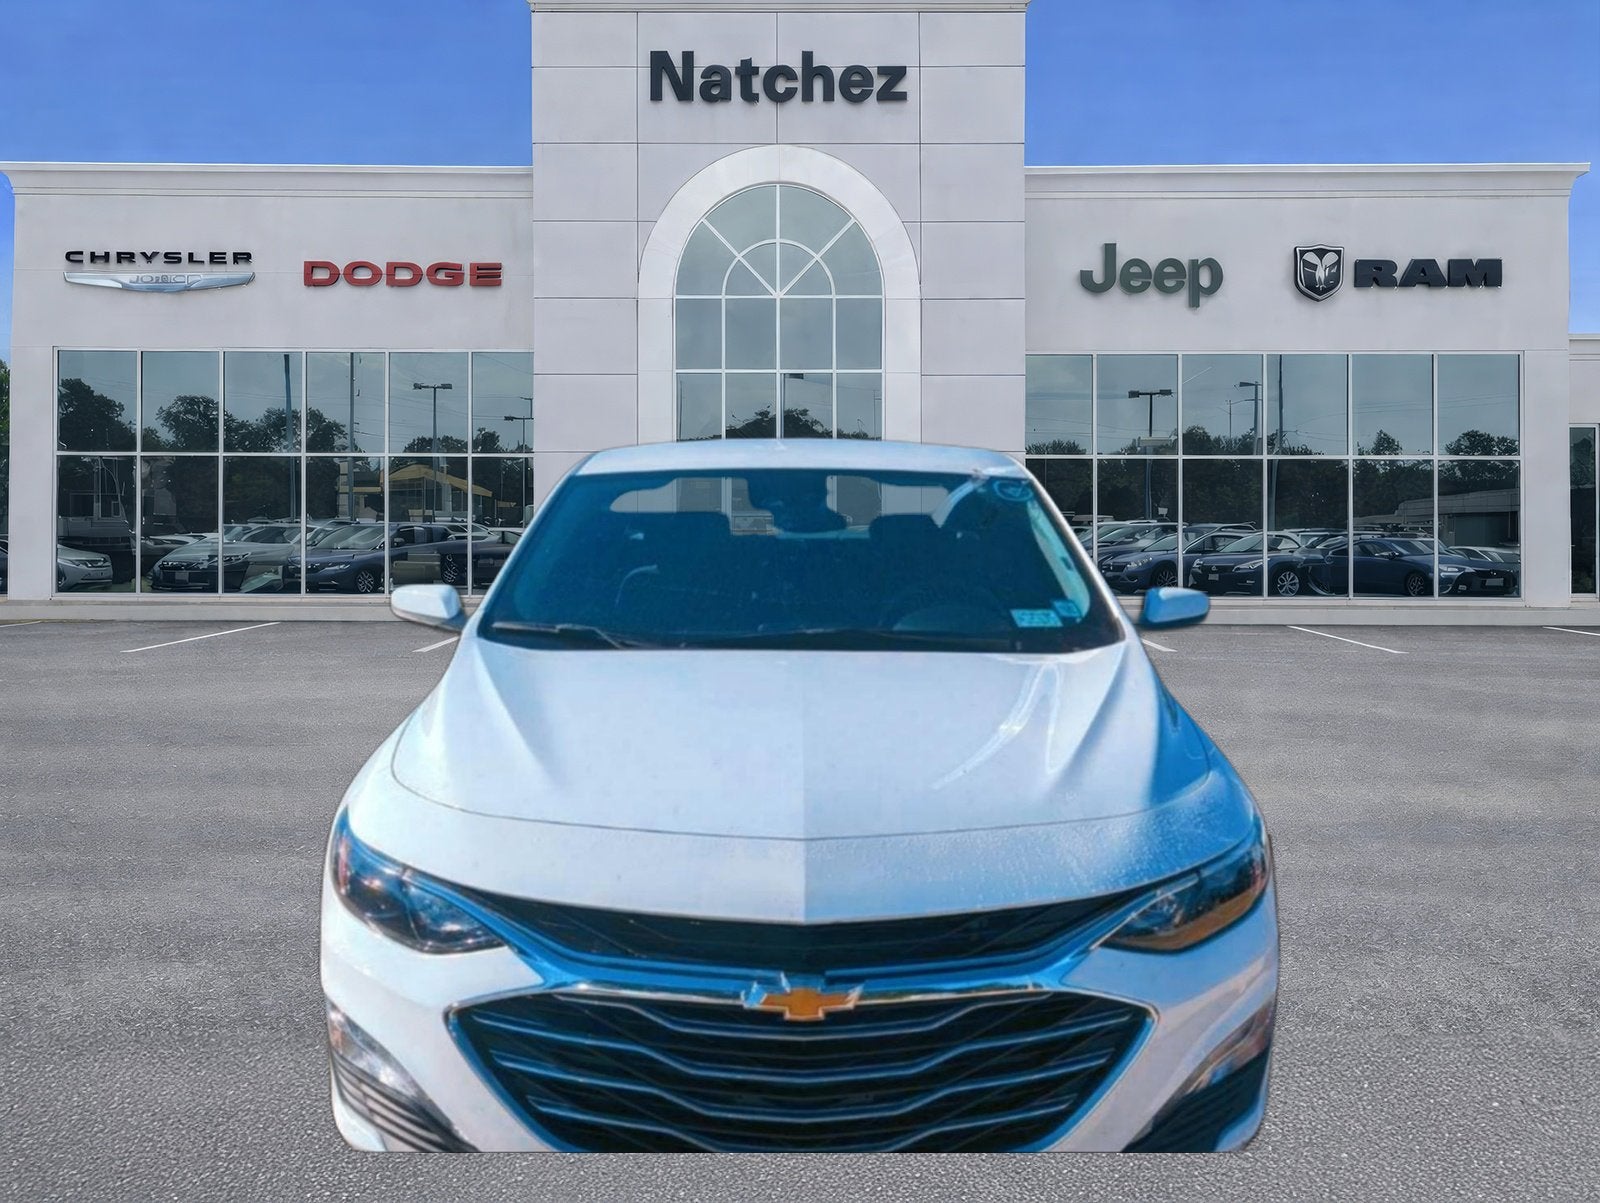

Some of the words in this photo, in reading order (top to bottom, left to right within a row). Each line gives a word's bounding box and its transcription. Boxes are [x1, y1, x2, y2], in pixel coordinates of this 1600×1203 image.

[649, 50, 908, 103] Natchez
[65, 251, 252, 266] CHRYSLER
[1354, 258, 1503, 288] RAM
[304, 261, 502, 288] DODGE
[1079, 242, 1224, 309] Jeep
